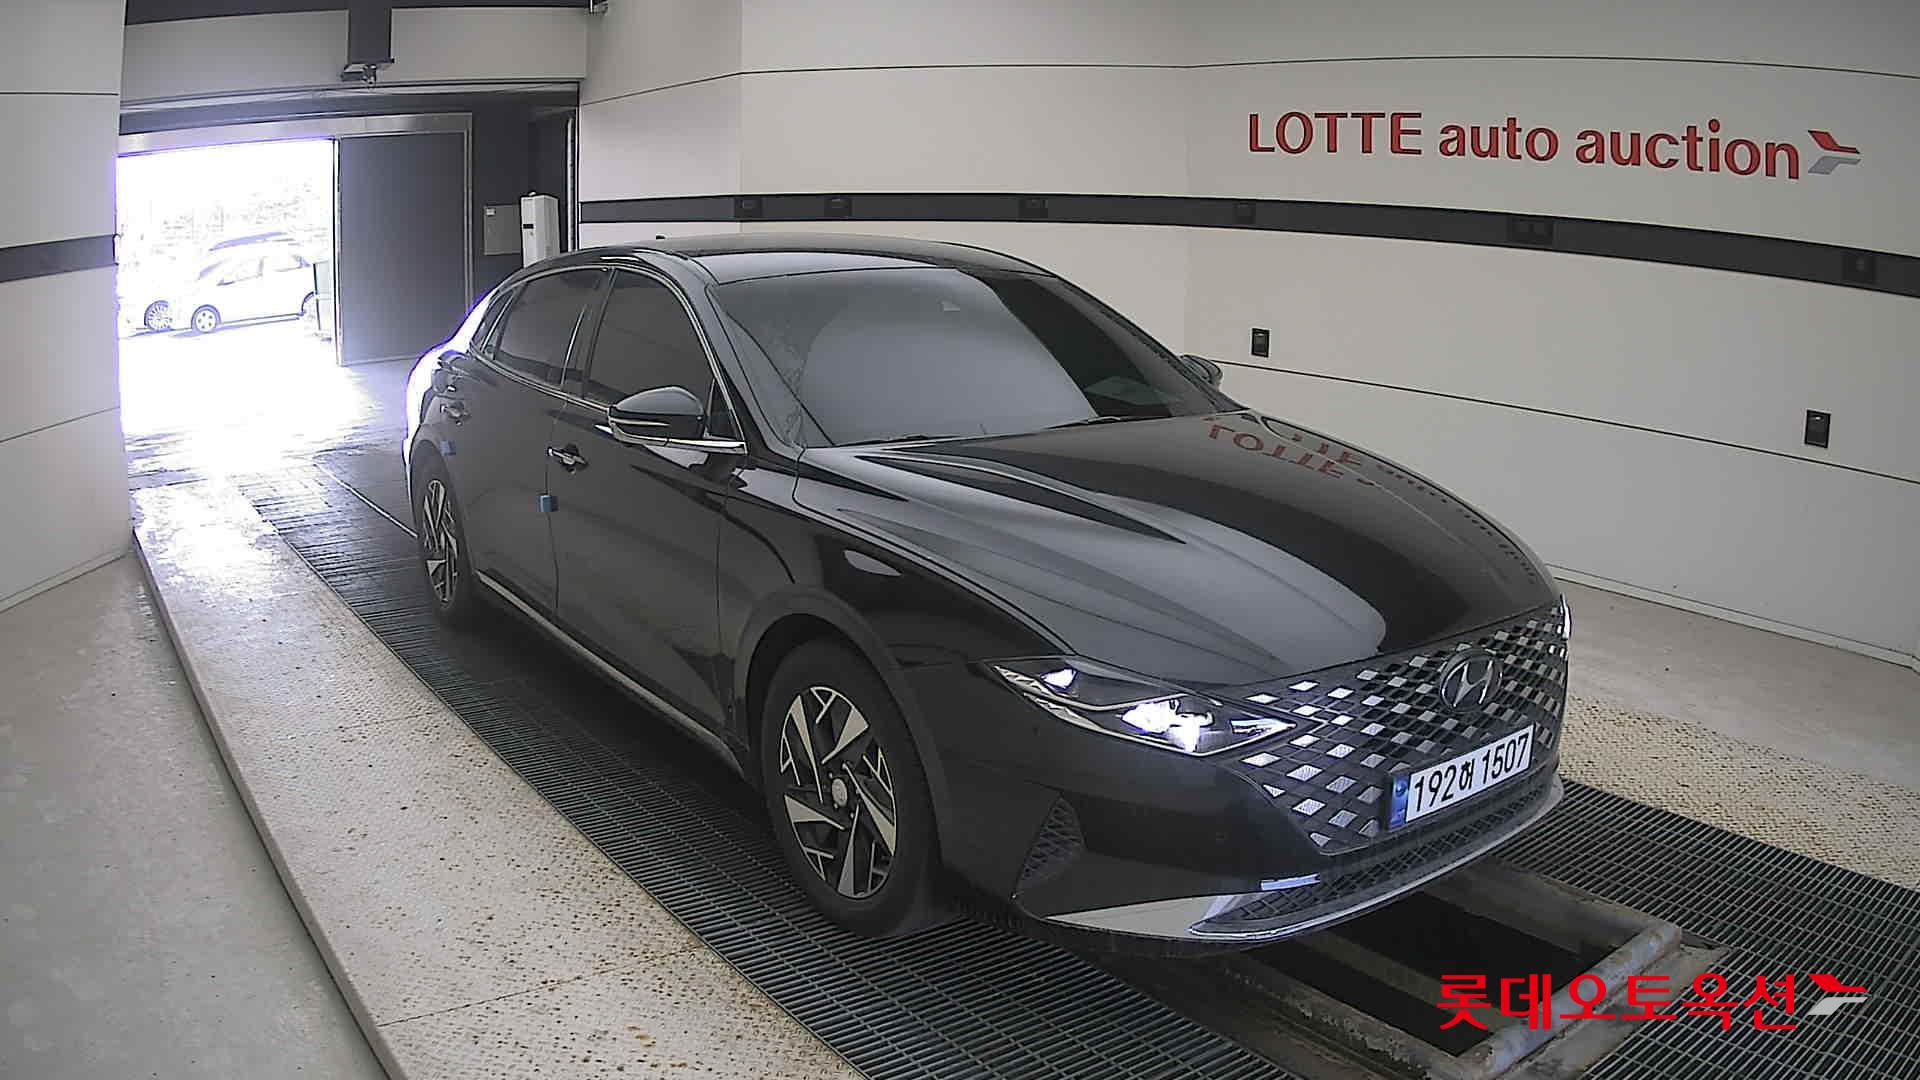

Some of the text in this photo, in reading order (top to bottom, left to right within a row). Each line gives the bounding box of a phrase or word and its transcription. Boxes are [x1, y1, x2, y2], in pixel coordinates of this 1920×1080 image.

[1248, 111, 1800, 180] LOTTE auto auction
[1414, 733, 1529, 812] 192허 1507
